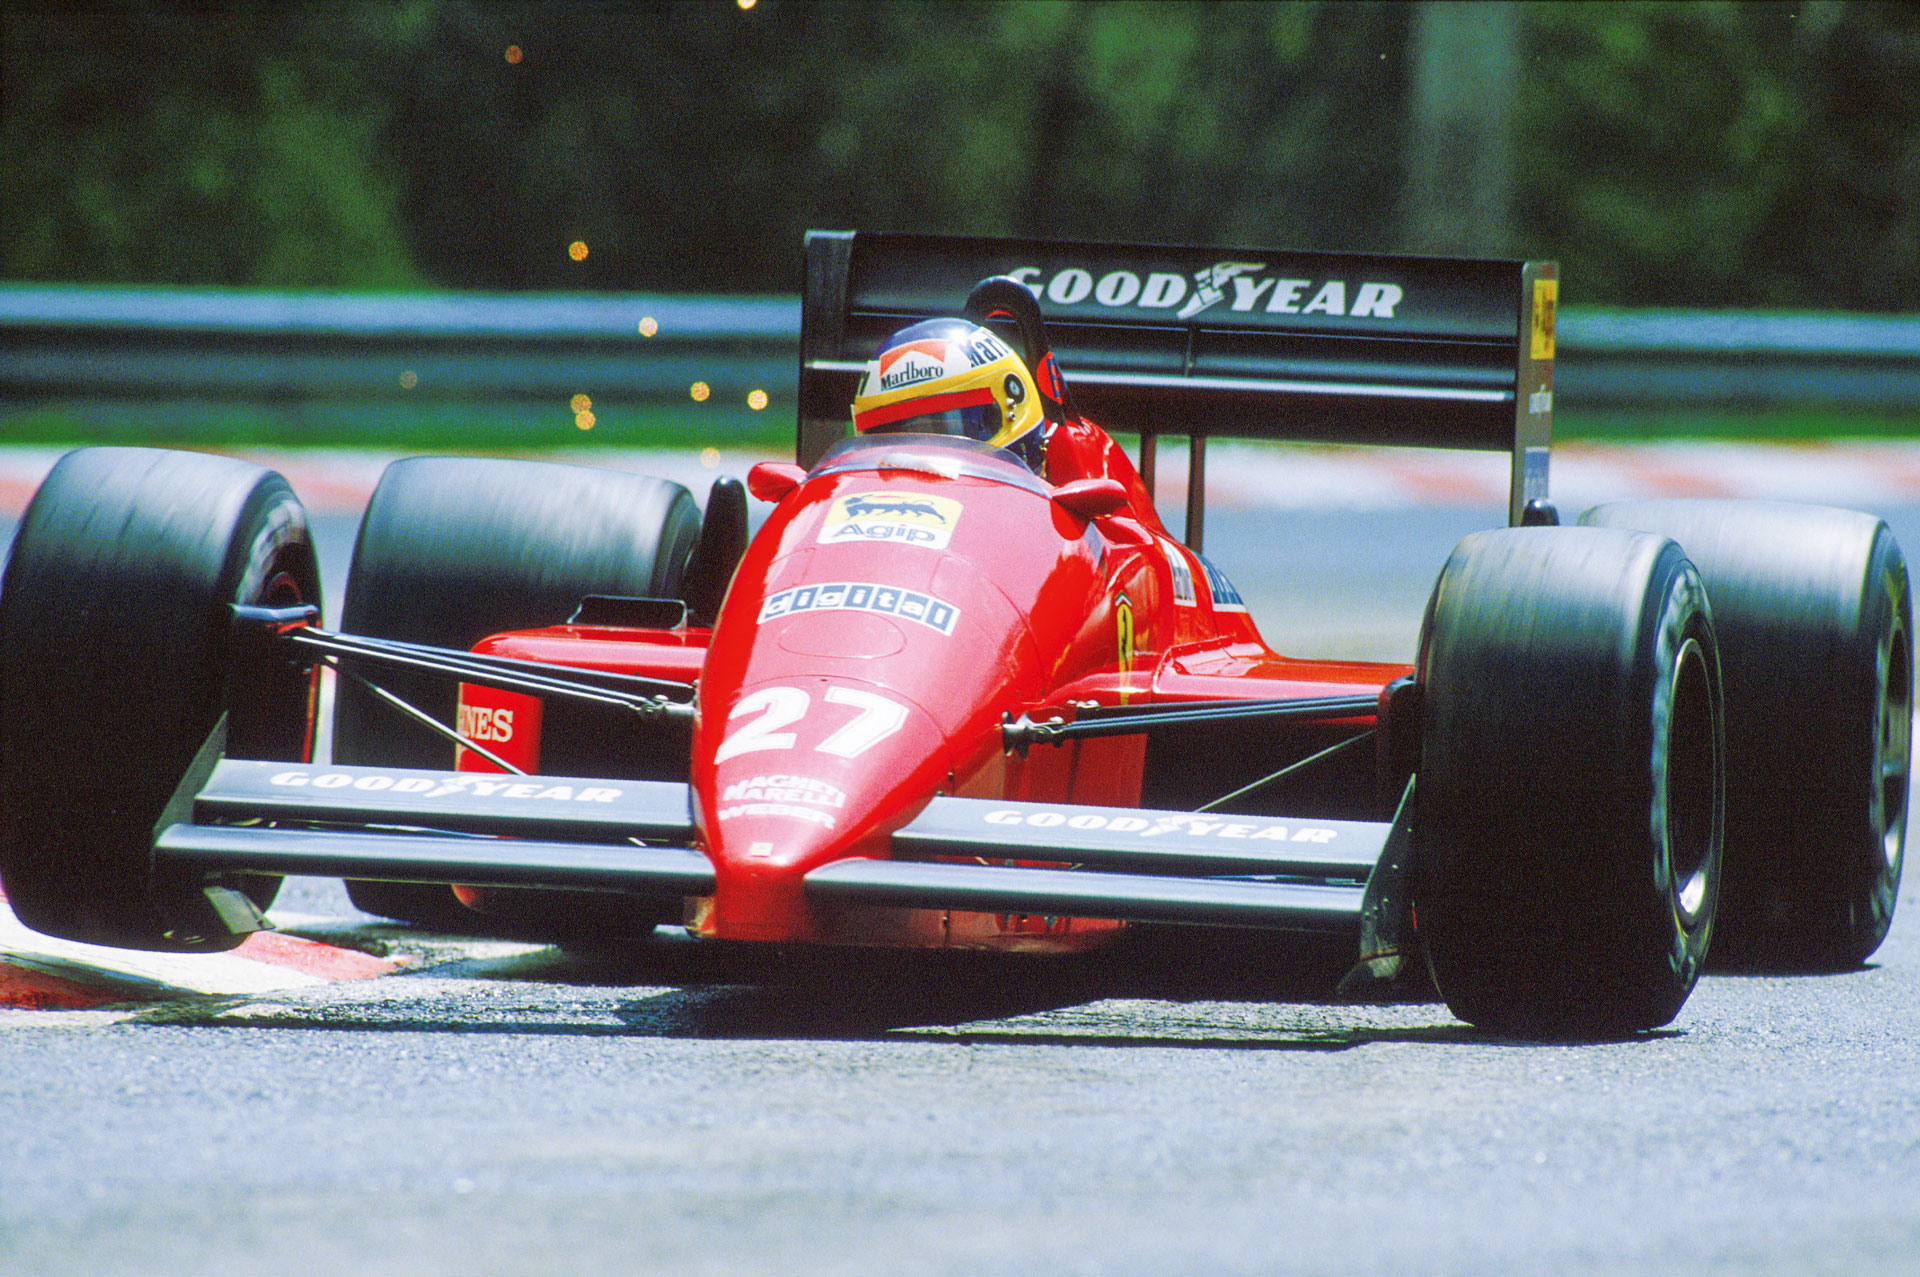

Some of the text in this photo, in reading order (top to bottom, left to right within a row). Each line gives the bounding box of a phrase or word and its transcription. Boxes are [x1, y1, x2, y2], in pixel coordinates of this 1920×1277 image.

[1006, 265, 1402, 319] GOODYEAR
[881, 360, 944, 391] Marlboro
[832, 523, 935, 542] Agip
[763, 584, 955, 633] digital
[713, 686, 910, 765] 27
[270, 771, 623, 802] GOODYEAR
[984, 810, 1338, 843] GOODYEAR
